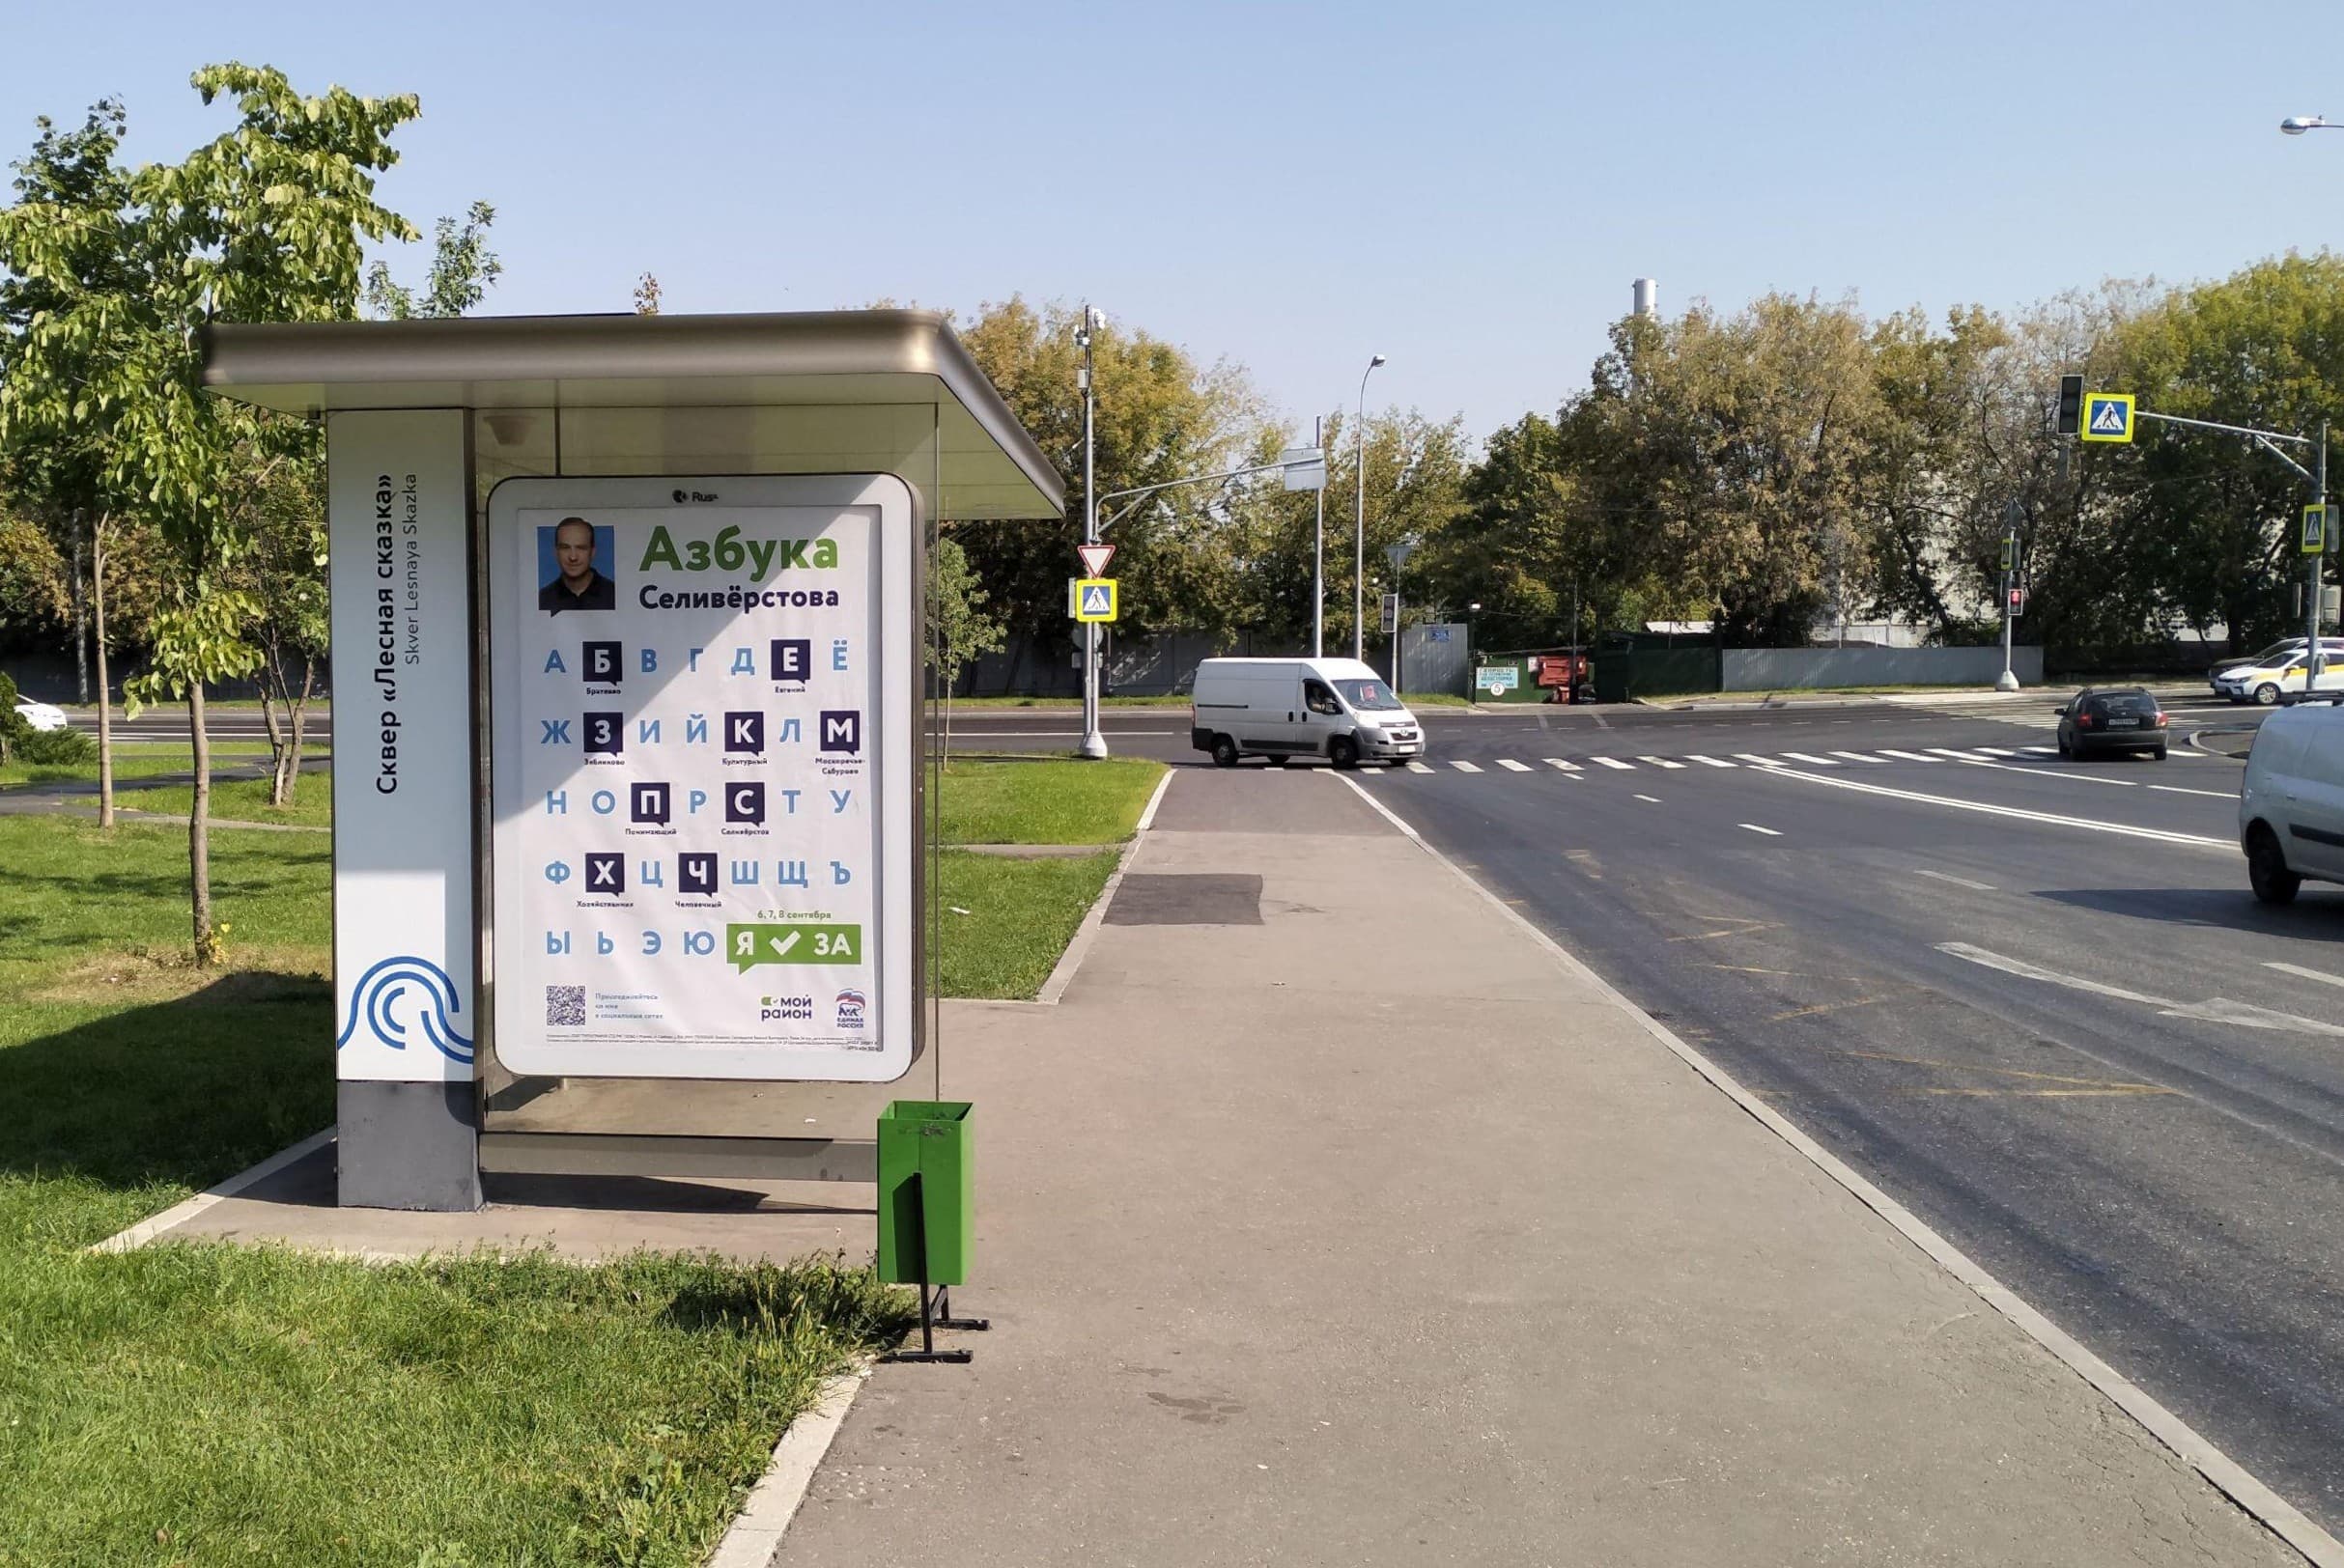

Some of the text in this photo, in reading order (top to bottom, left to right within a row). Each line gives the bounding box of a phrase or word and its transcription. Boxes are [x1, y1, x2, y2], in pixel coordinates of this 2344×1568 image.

[639, 525, 838, 582] Азбука
[402, 474, 421, 664] Skver Lesnaya Skazka
[639, 585, 839, 614] Селивёрстова
[374, 474, 402, 794] Сквер «Лесная сказка»
[545, 639, 847, 676] А Б В Г Д Е Ё
[541, 714, 853, 743] Ж З И Й К Л М
[548, 790, 851, 814] Н О П Р С Т У
[546, 861, 851, 888] Ф Х Ц Ч Ш Щ Ъ
[757, 910, 766, 919] 6,
[768, 910, 777, 919] 7,
[787, 910, 832, 920] сентября
[547, 931, 715, 955] Ы Ь Э Ю
[736, 932, 852, 955] Я ЗА
[780, 994, 811, 1007] мой
